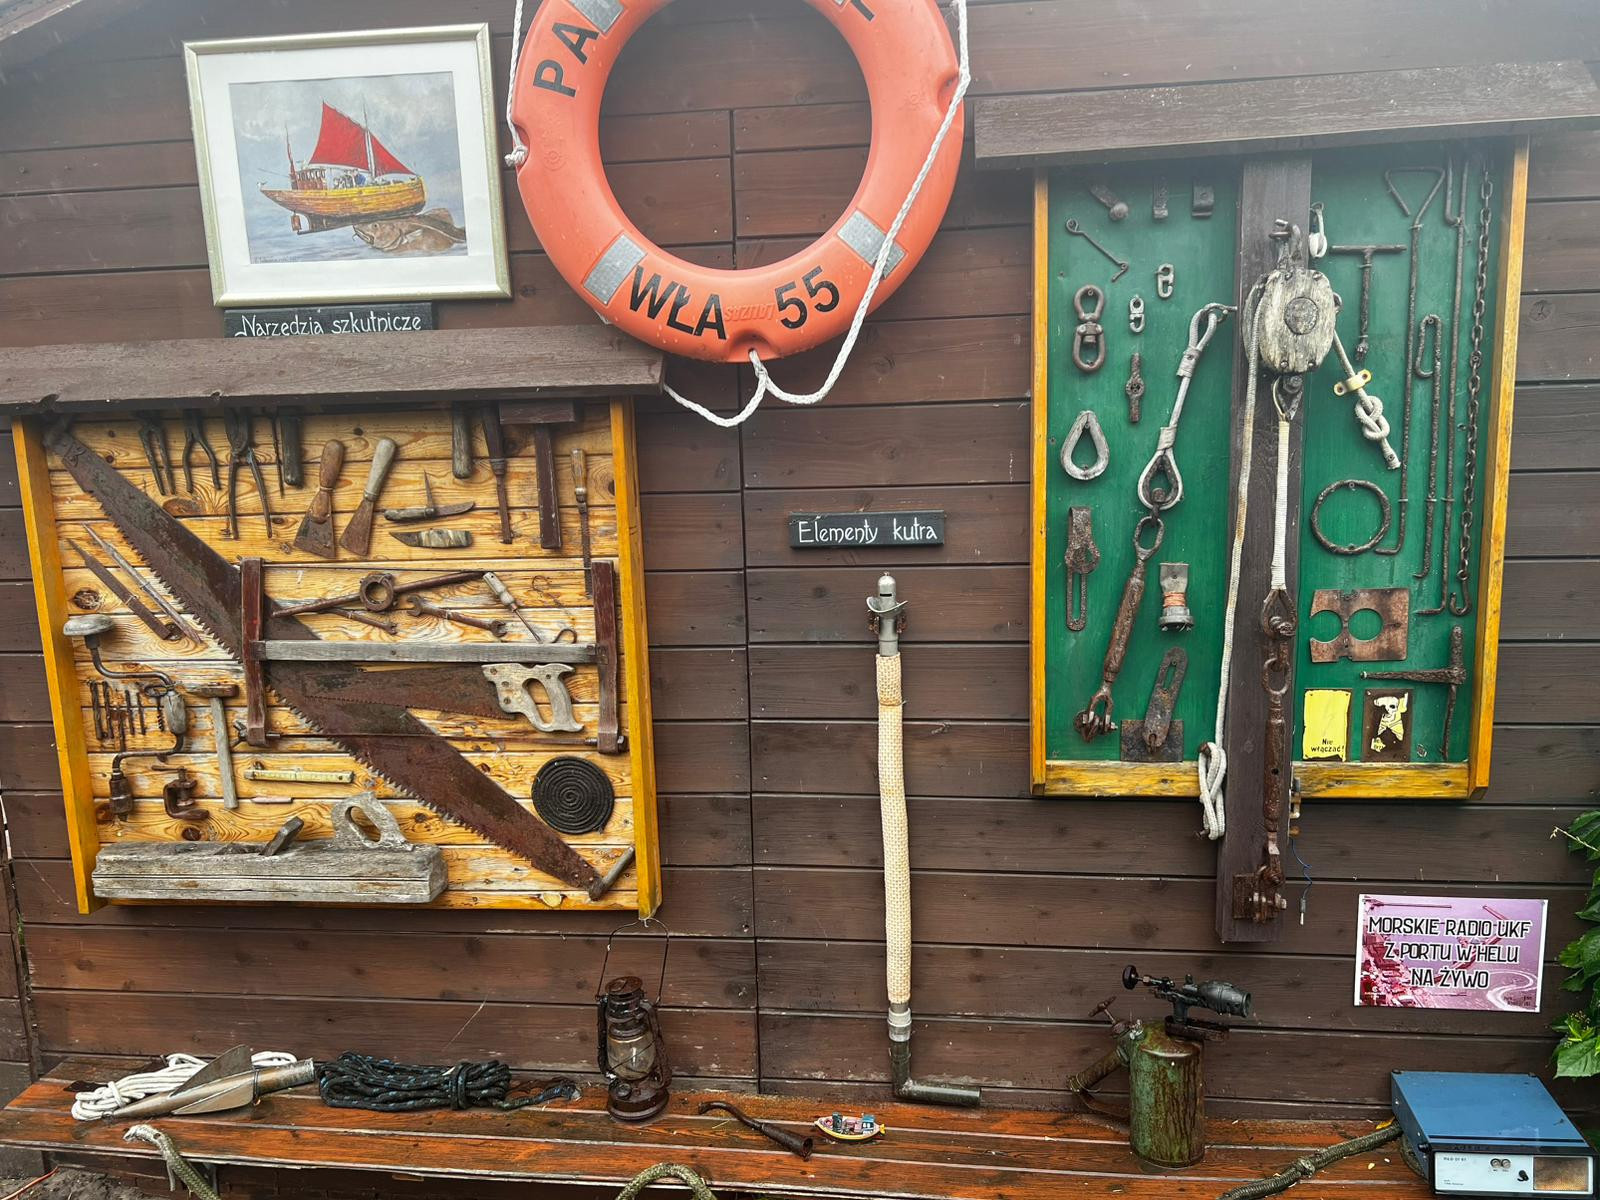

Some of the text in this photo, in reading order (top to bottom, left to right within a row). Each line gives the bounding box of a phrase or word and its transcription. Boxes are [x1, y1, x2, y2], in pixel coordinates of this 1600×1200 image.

[627, 265, 840, 341] WŁA 55
[331, 310, 422, 335] szkutnicze
[798, 517, 938, 544] Elementy kutra
[1368, 916, 1531, 938] MORSKIE RADIO UKF
[1385, 942, 1519, 963] Z PORTU W HELU
[1411, 966, 1489, 988] NA ŻYWO
